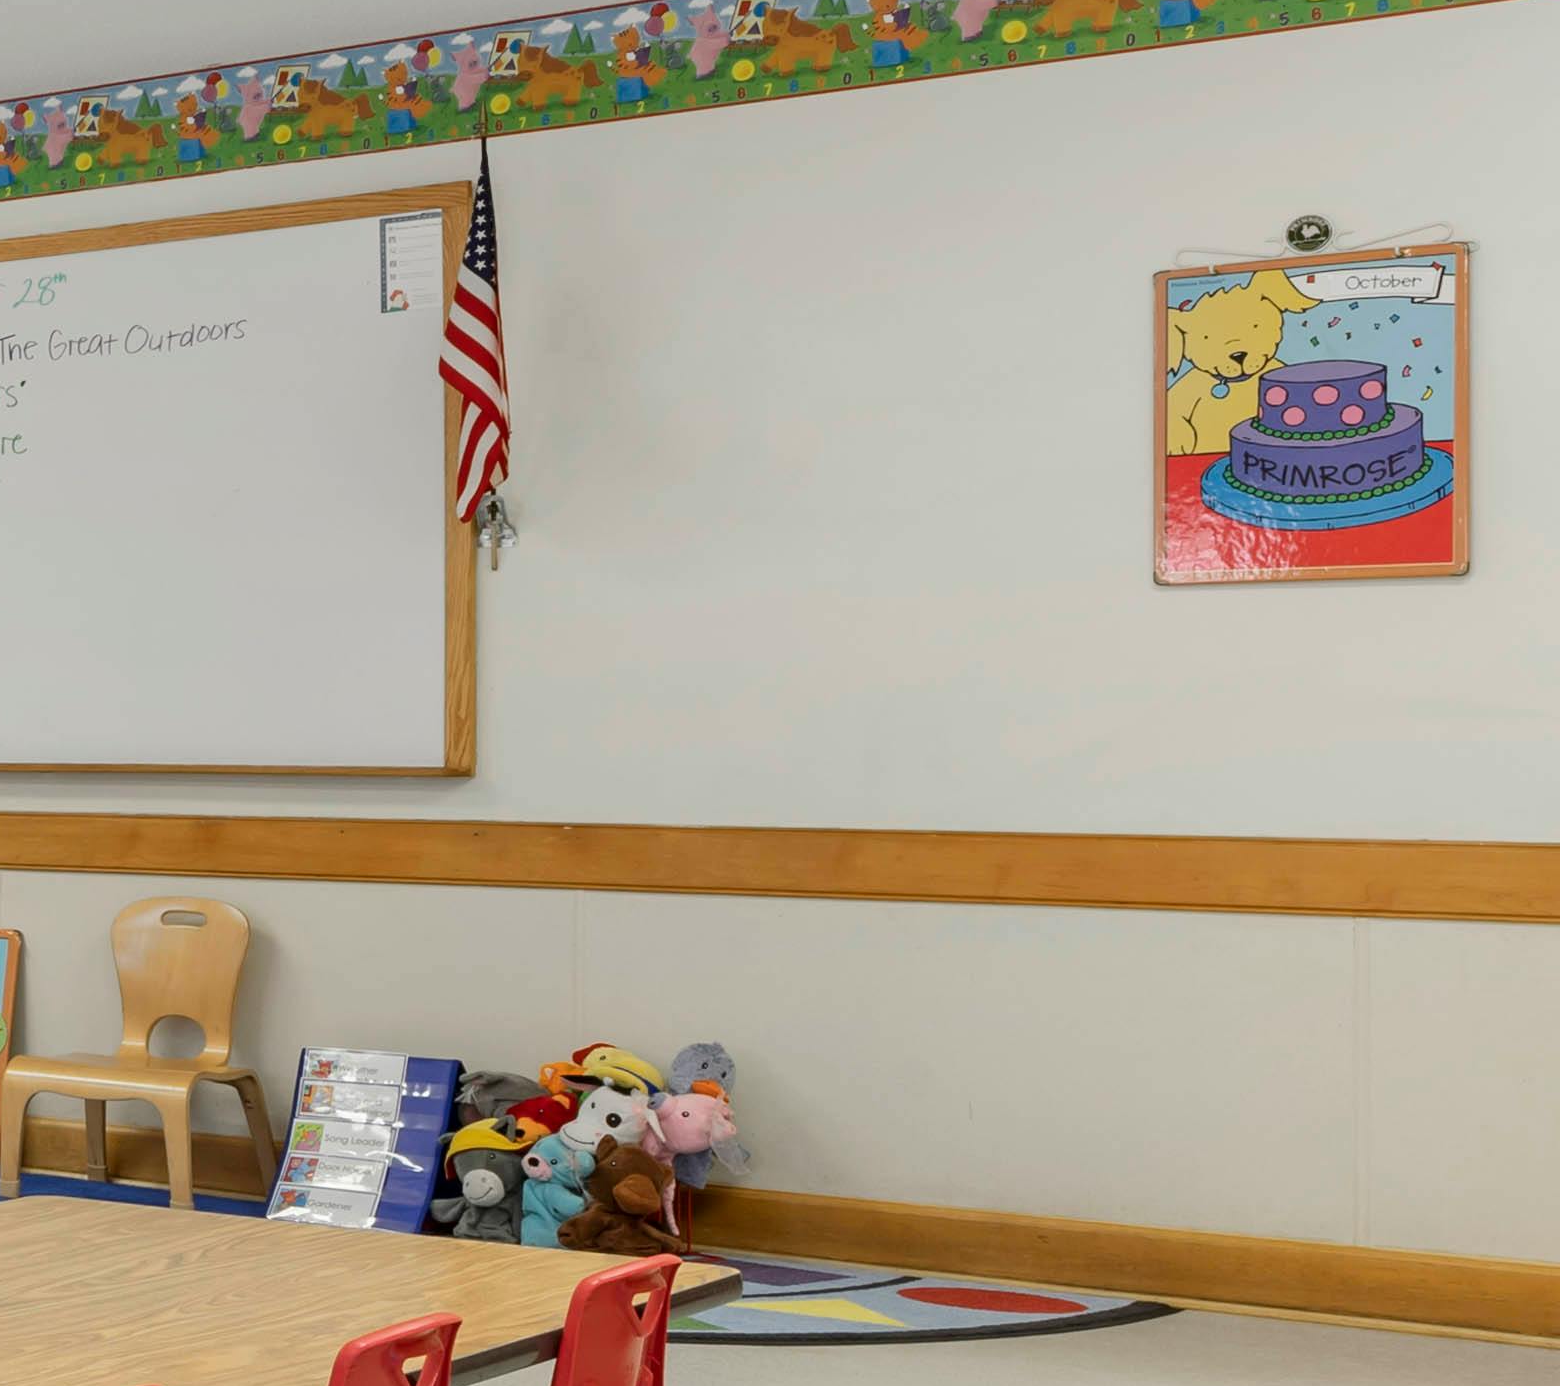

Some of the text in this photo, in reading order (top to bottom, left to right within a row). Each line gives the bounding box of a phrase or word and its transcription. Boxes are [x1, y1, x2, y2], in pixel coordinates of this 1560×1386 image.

[157, 167, 163, 176] 0
[177, 165, 180, 173] 1
[196, 161, 202, 171] 2
[257, 153, 263, 163] 5
[299, 146, 306, 157] 7
[364, 138, 370, 150] 0
[385, 136, 389, 146] 1
[405, 132, 412, 143] 2
[519, 117, 525, 129] 7
[591, 108, 597, 118] 0
[614, 105, 619, 116] 1
[638, 102, 645, 113] 2
[712, 91, 720, 102] 5
[765, 84, 772, 95] 7
[844, 73, 851, 84] 0
[869, 70, 874, 81] 1
[896, 66, 904, 78] 2
[980, 54, 988, 66] 5
[1038, 46, 1046, 58] 7
[1127, 34, 1135, 46] 0
[1155, 30, 1161, 42] 1
[1185, 25, 1194, 39] 2
[1280, 13, 1289, 25] 5
[1346, 3, 1356, 16] 7
[13, 272, 68, 309] 28th
[1344, 274, 1423, 291] October
[48, 329, 119, 361] Great
[124, 318, 248, 355] Outdoors
[324, 1133, 386, 1147] Song Leader
